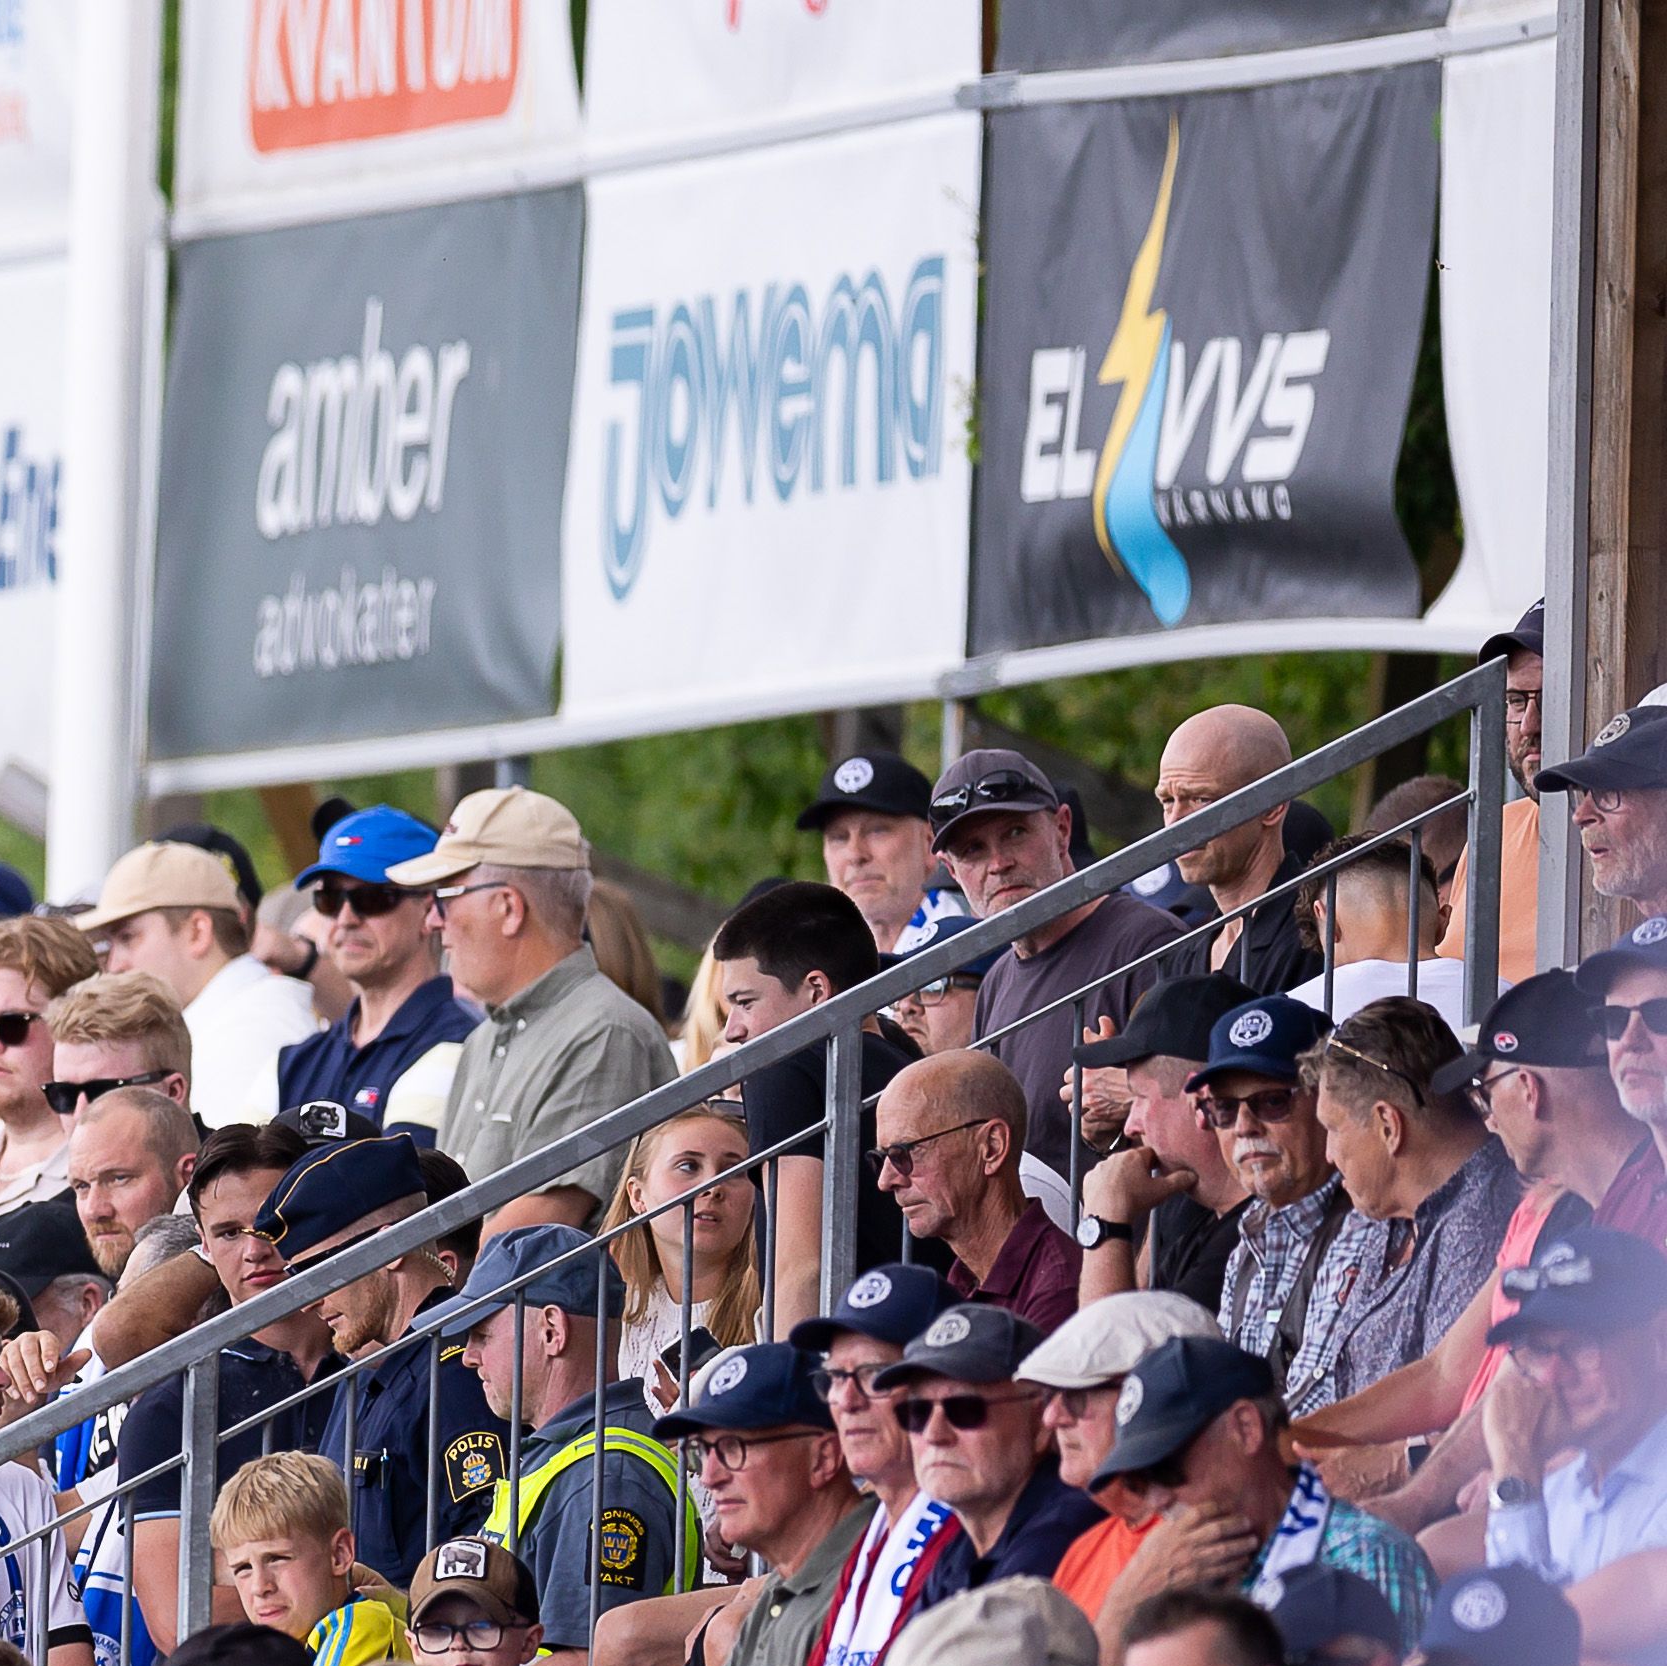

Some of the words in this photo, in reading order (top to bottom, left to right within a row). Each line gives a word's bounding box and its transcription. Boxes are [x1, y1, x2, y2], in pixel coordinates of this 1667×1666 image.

[256, 298, 471, 539] amber
[1021, 346, 1097, 503] EL
[1156, 329, 1331, 490] VVS
[253, 564, 437, 678] advokater
[448, 1435, 495, 1461] POLIS
[590, 1510, 645, 1536] DNINGS
[600, 1573, 635, 1585] AKT
